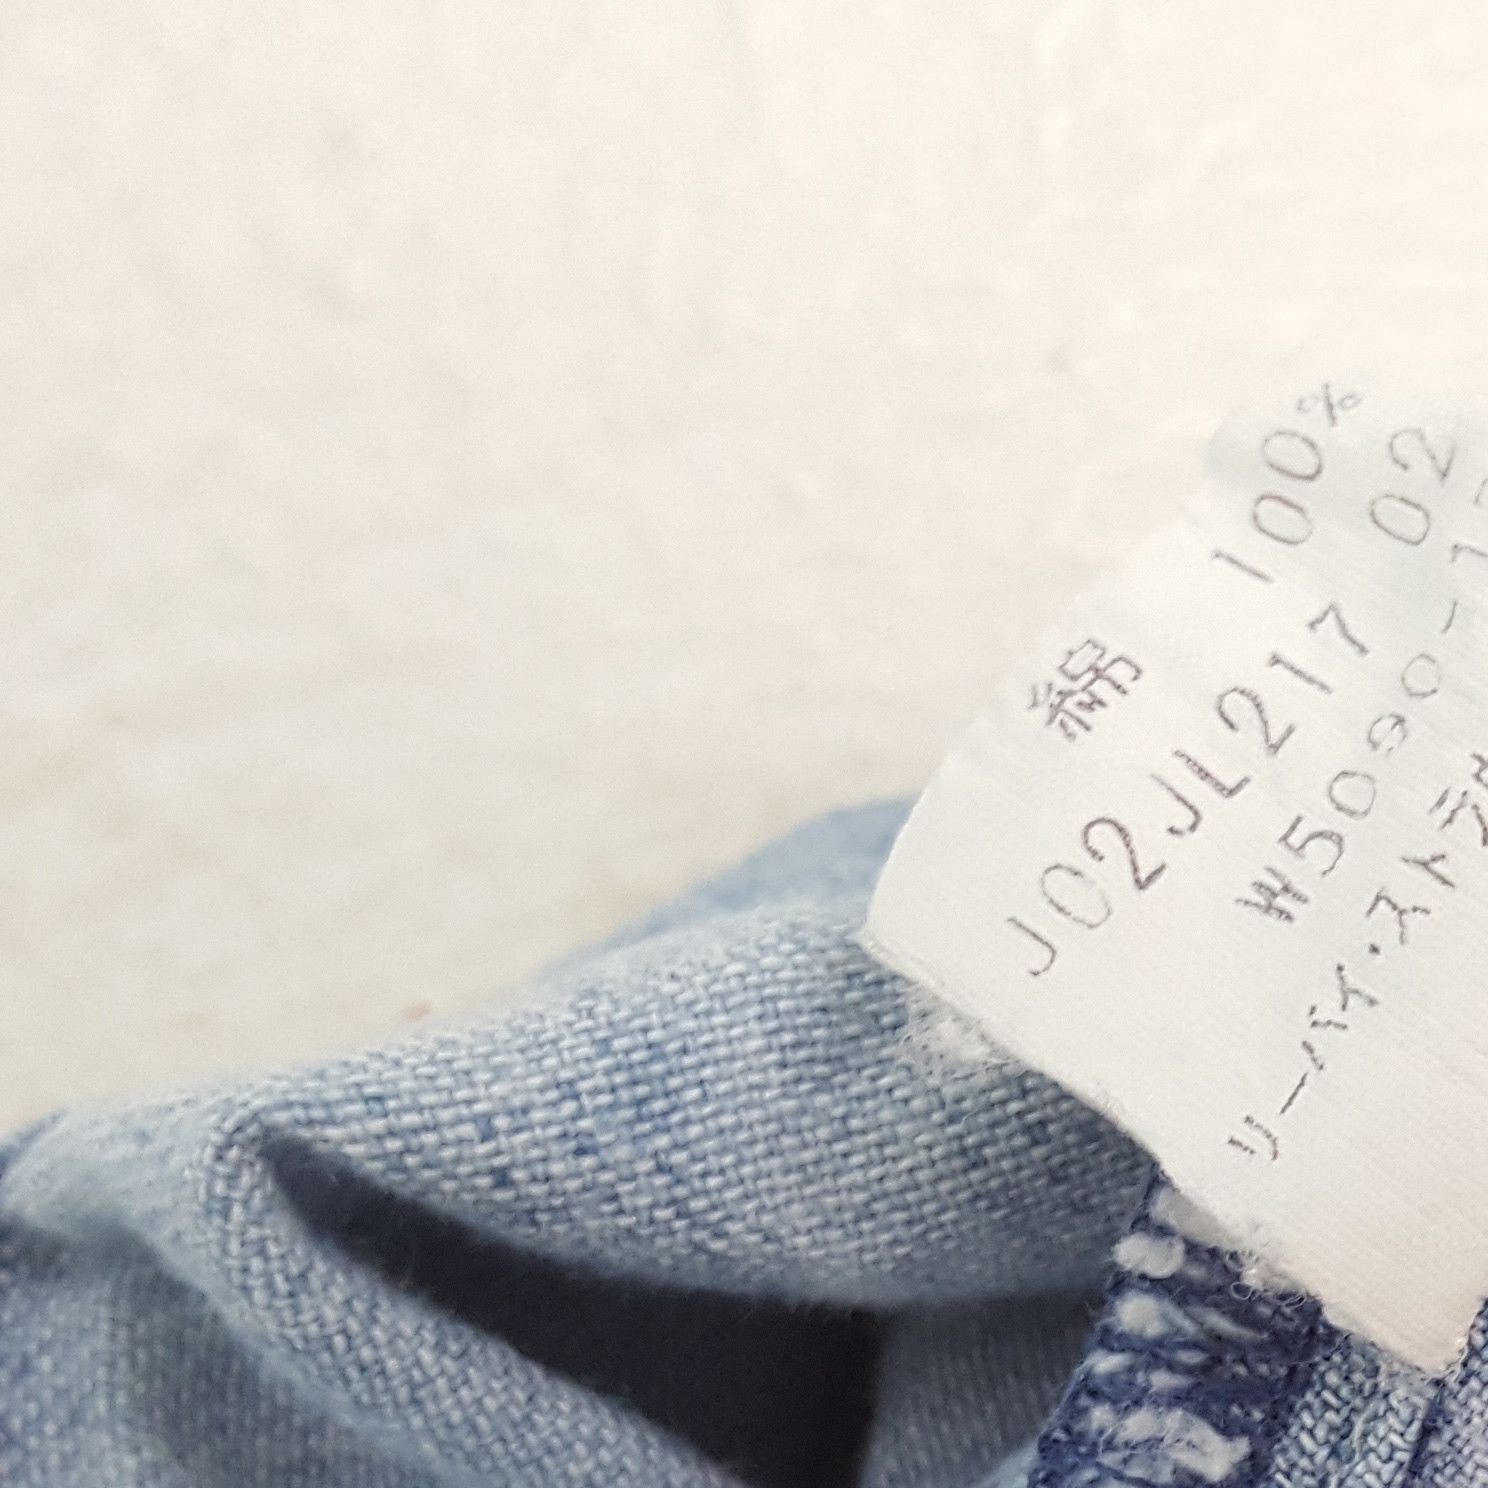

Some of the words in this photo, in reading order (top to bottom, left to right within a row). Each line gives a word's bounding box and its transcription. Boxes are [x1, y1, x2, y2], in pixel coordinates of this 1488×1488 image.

[1212, 381, 1362, 583] 100%
[1006, 601, 1369, 977] J02JL217
[1368, 427, 1457, 546] 02
[1027, 638, 1143, 740] 綿
